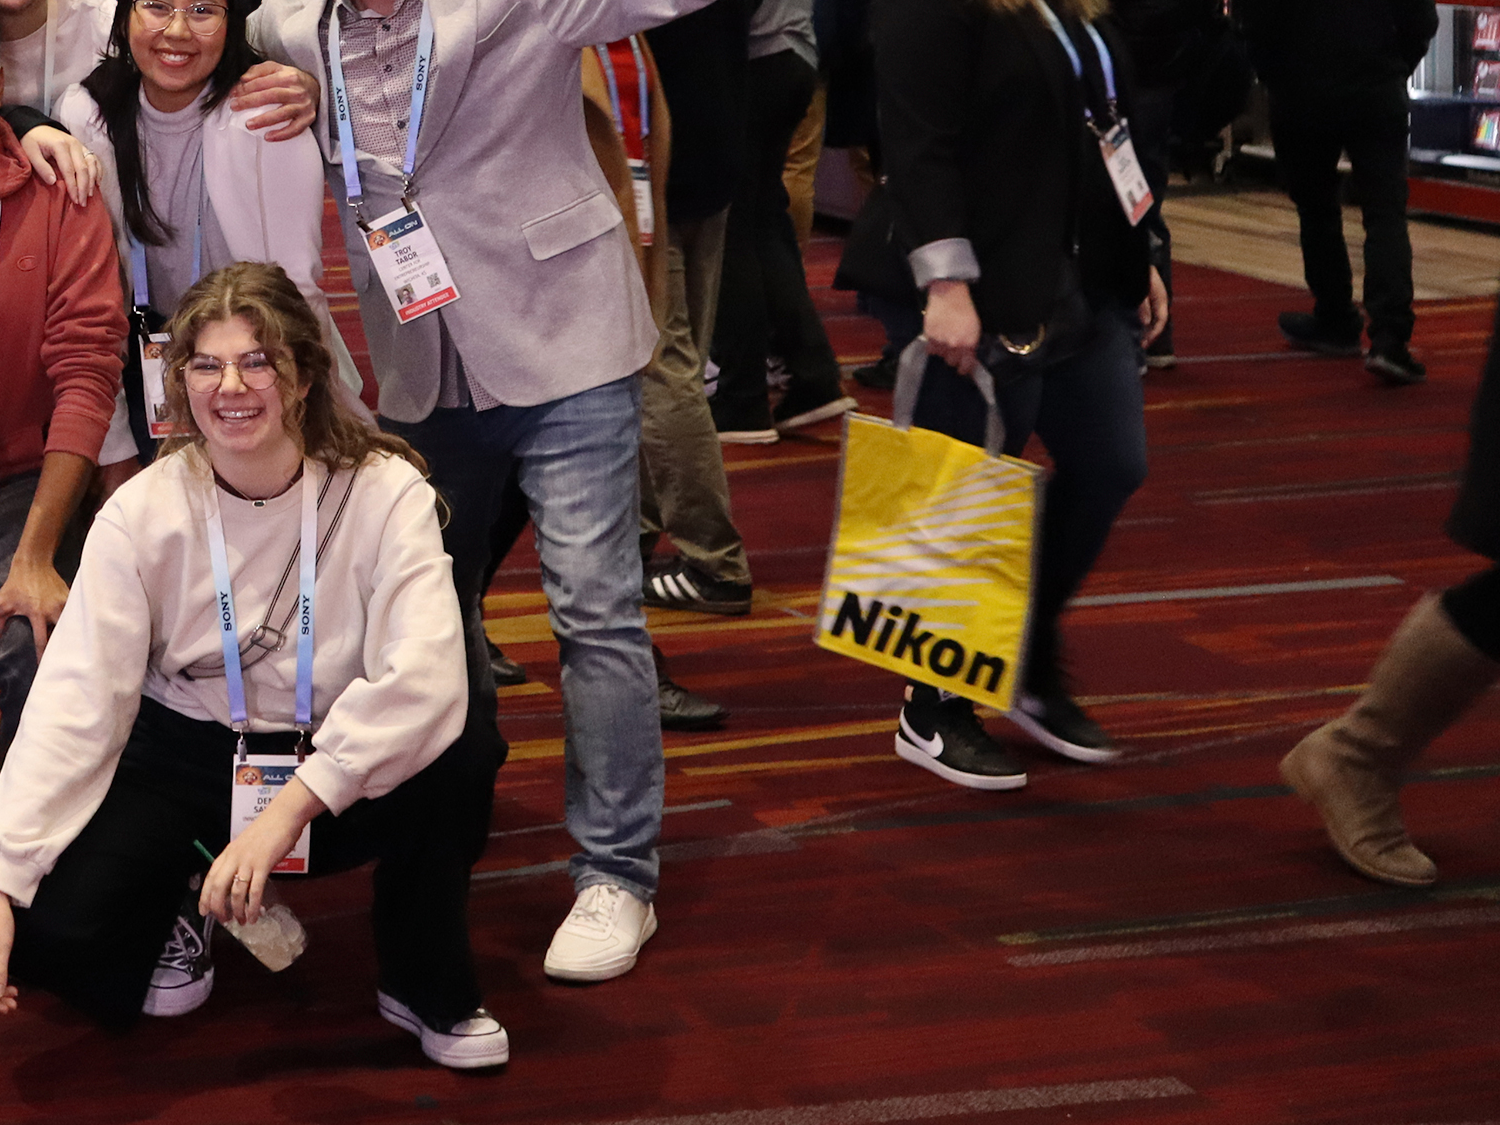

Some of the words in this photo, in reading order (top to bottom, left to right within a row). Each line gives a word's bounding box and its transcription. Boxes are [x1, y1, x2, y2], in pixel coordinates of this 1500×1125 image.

[415, 55, 427, 91] SONY
[335, 87, 346, 121] SONY
[394, 245, 412, 258] TROY
[396, 251, 419, 265] TABOR
[220, 591, 232, 632] SONY
[301, 594, 310, 635] SONY
[830, 591, 1006, 694] Nikon
